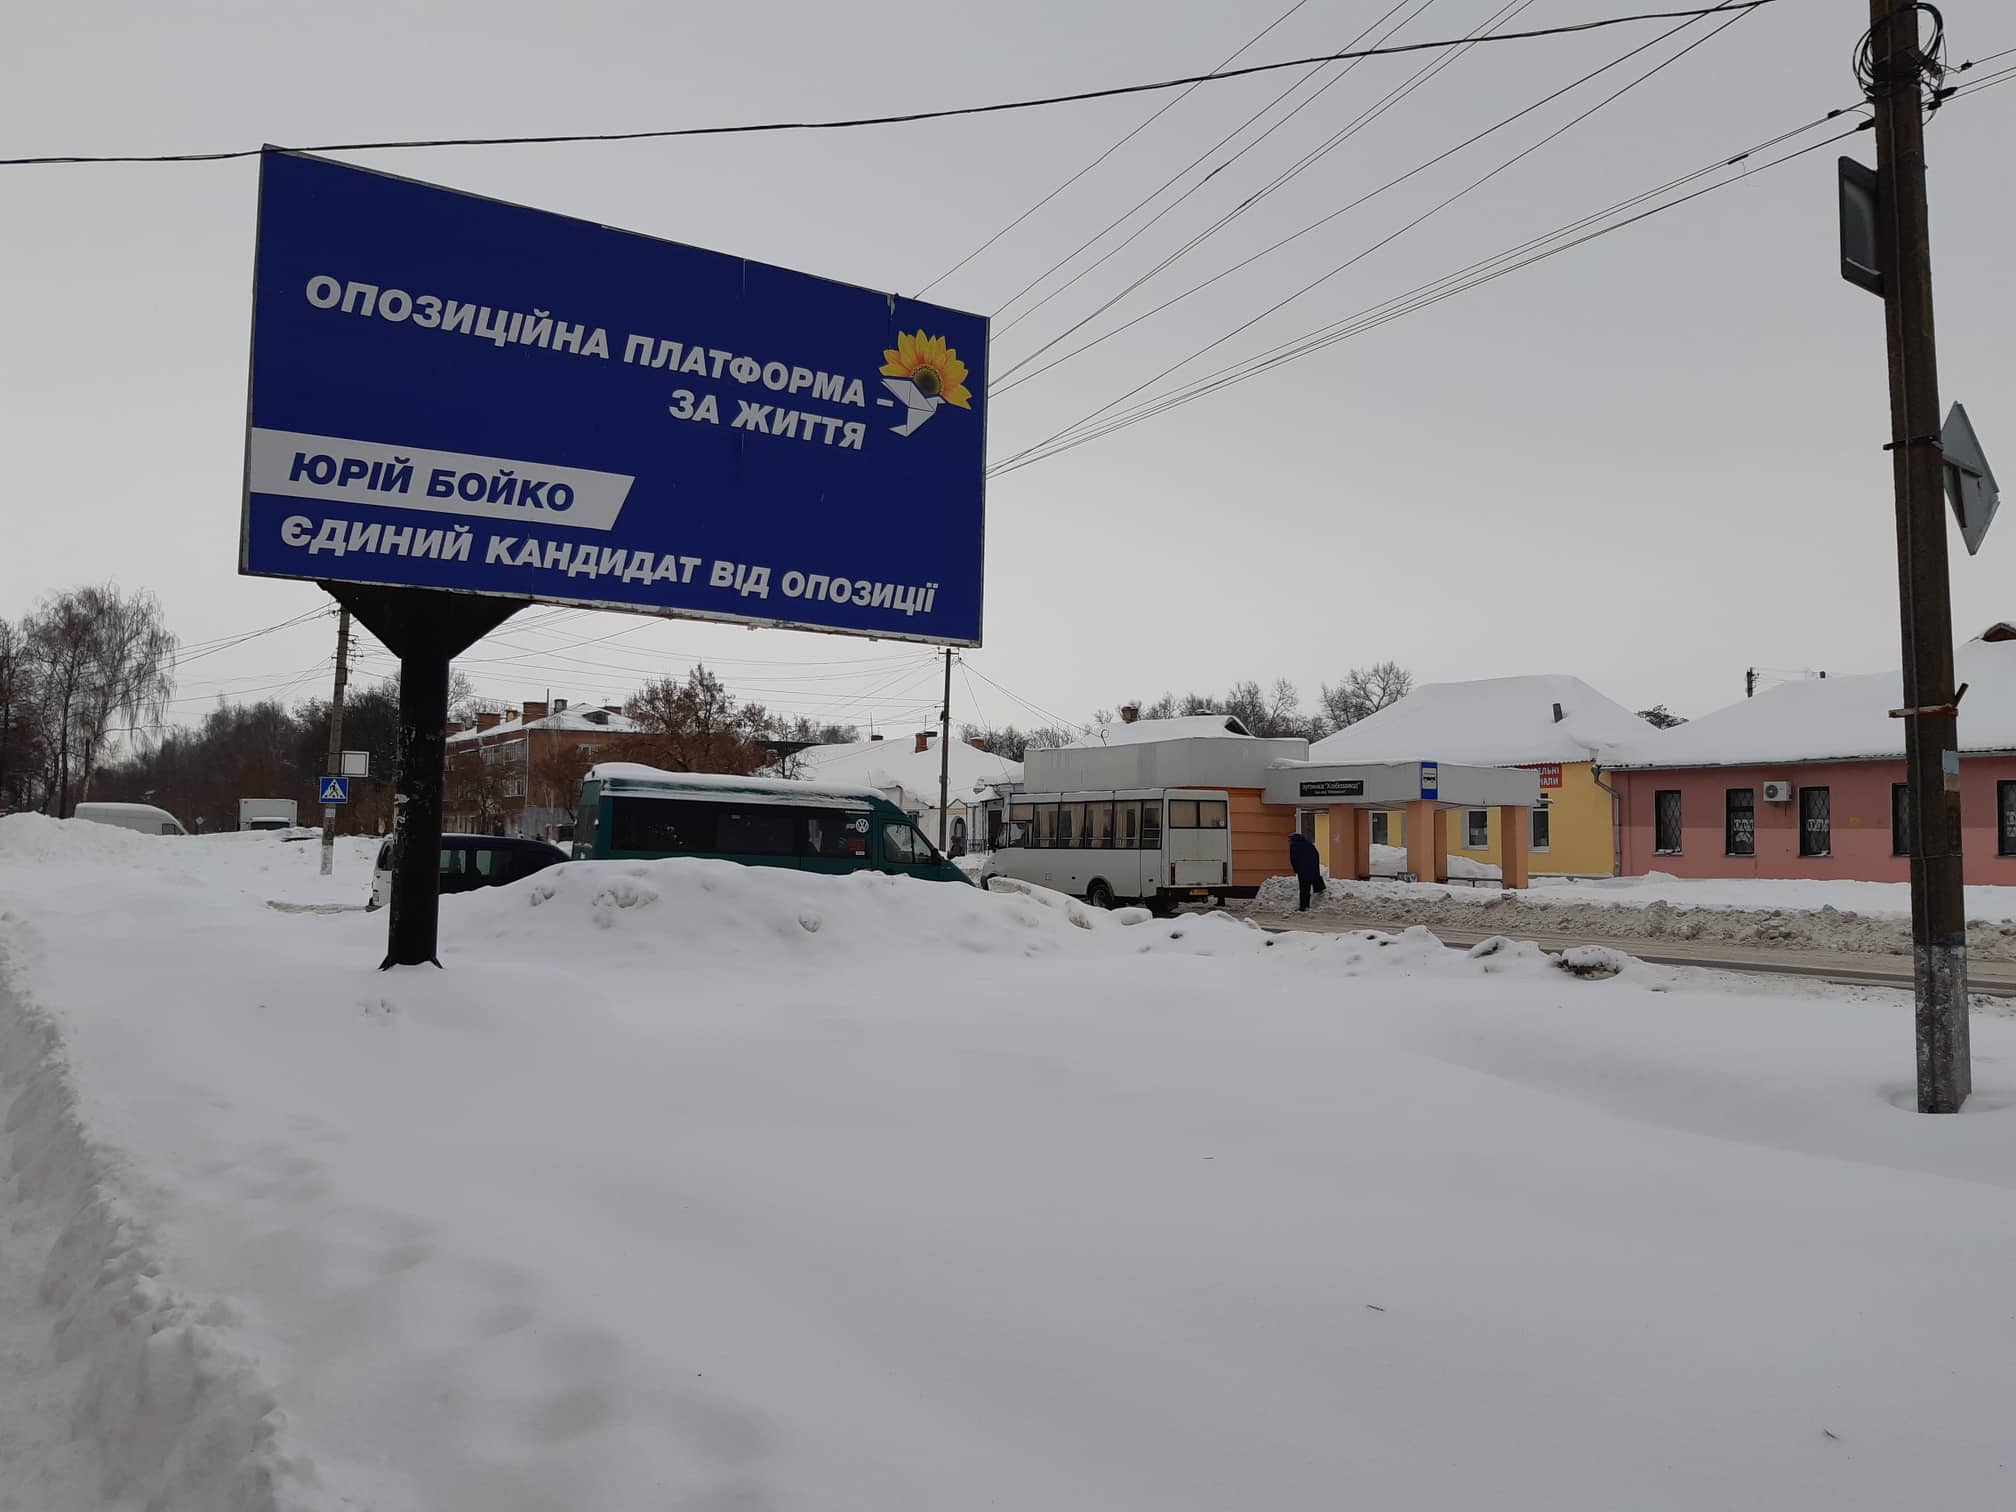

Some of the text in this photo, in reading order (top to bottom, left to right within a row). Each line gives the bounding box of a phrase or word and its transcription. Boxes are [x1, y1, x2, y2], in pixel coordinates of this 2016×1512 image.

[306, 275, 609, 358] ОПОЗИЦІЙНА
[623, 334, 865, 407] ПЛАТФОРМА
[669, 389, 866, 450] ЗА ЖИТТЯ
[288, 451, 575, 512] ЮРІЙ БОЙКО
[281, 515, 939, 616] ЄДИНИЙ КАНДИДАТ ВІД ОПОЗИЦІЇ
